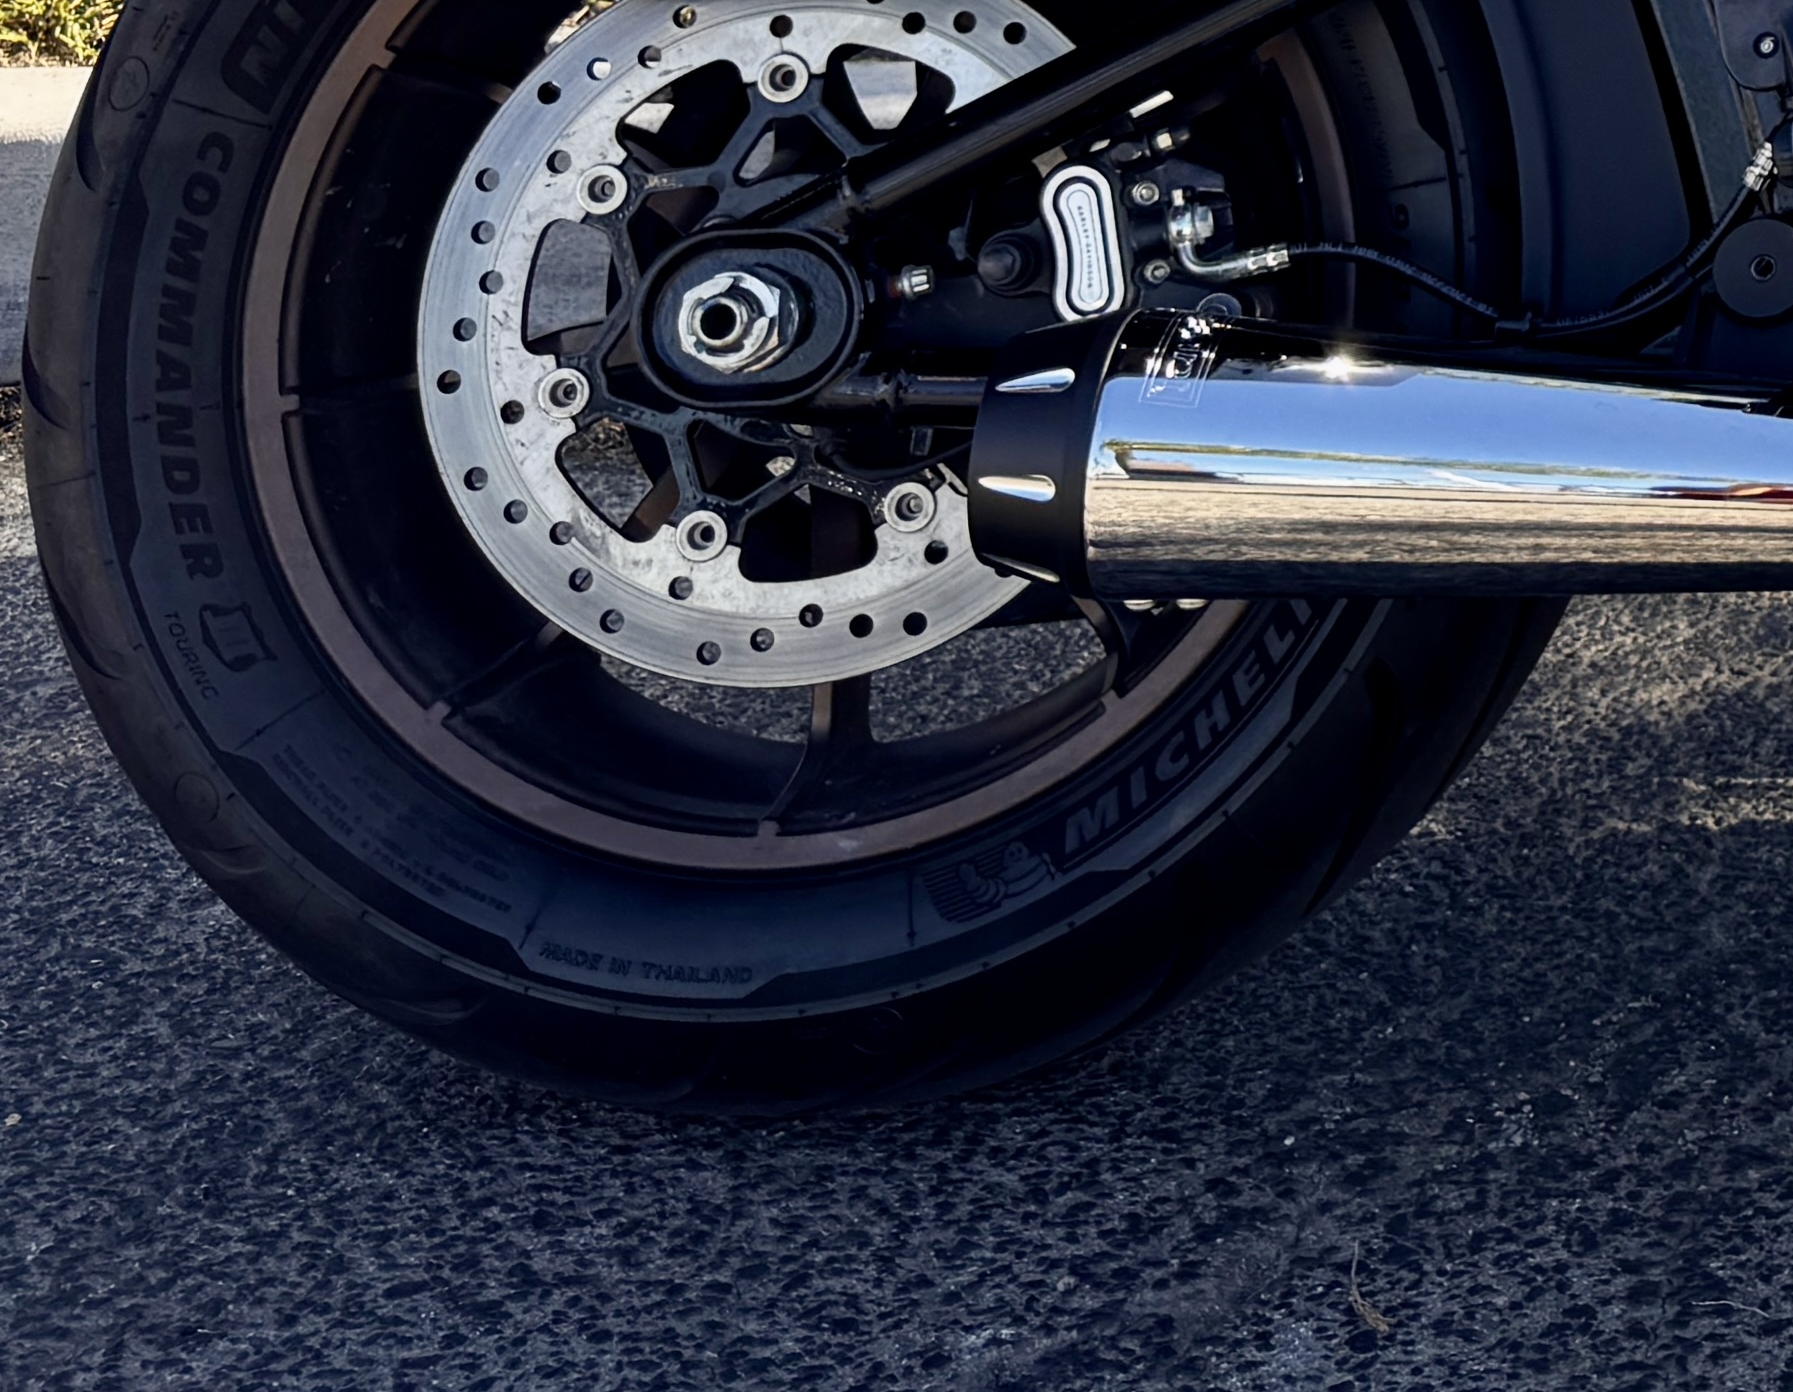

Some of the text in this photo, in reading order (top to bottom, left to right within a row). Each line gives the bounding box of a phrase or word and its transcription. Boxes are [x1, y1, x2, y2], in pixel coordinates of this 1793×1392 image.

[155, 131, 235, 581] COMMANDER
[1065, 599, 1315, 848] MICHELI
[538, 940, 753, 984] MADE IN THAILAND
